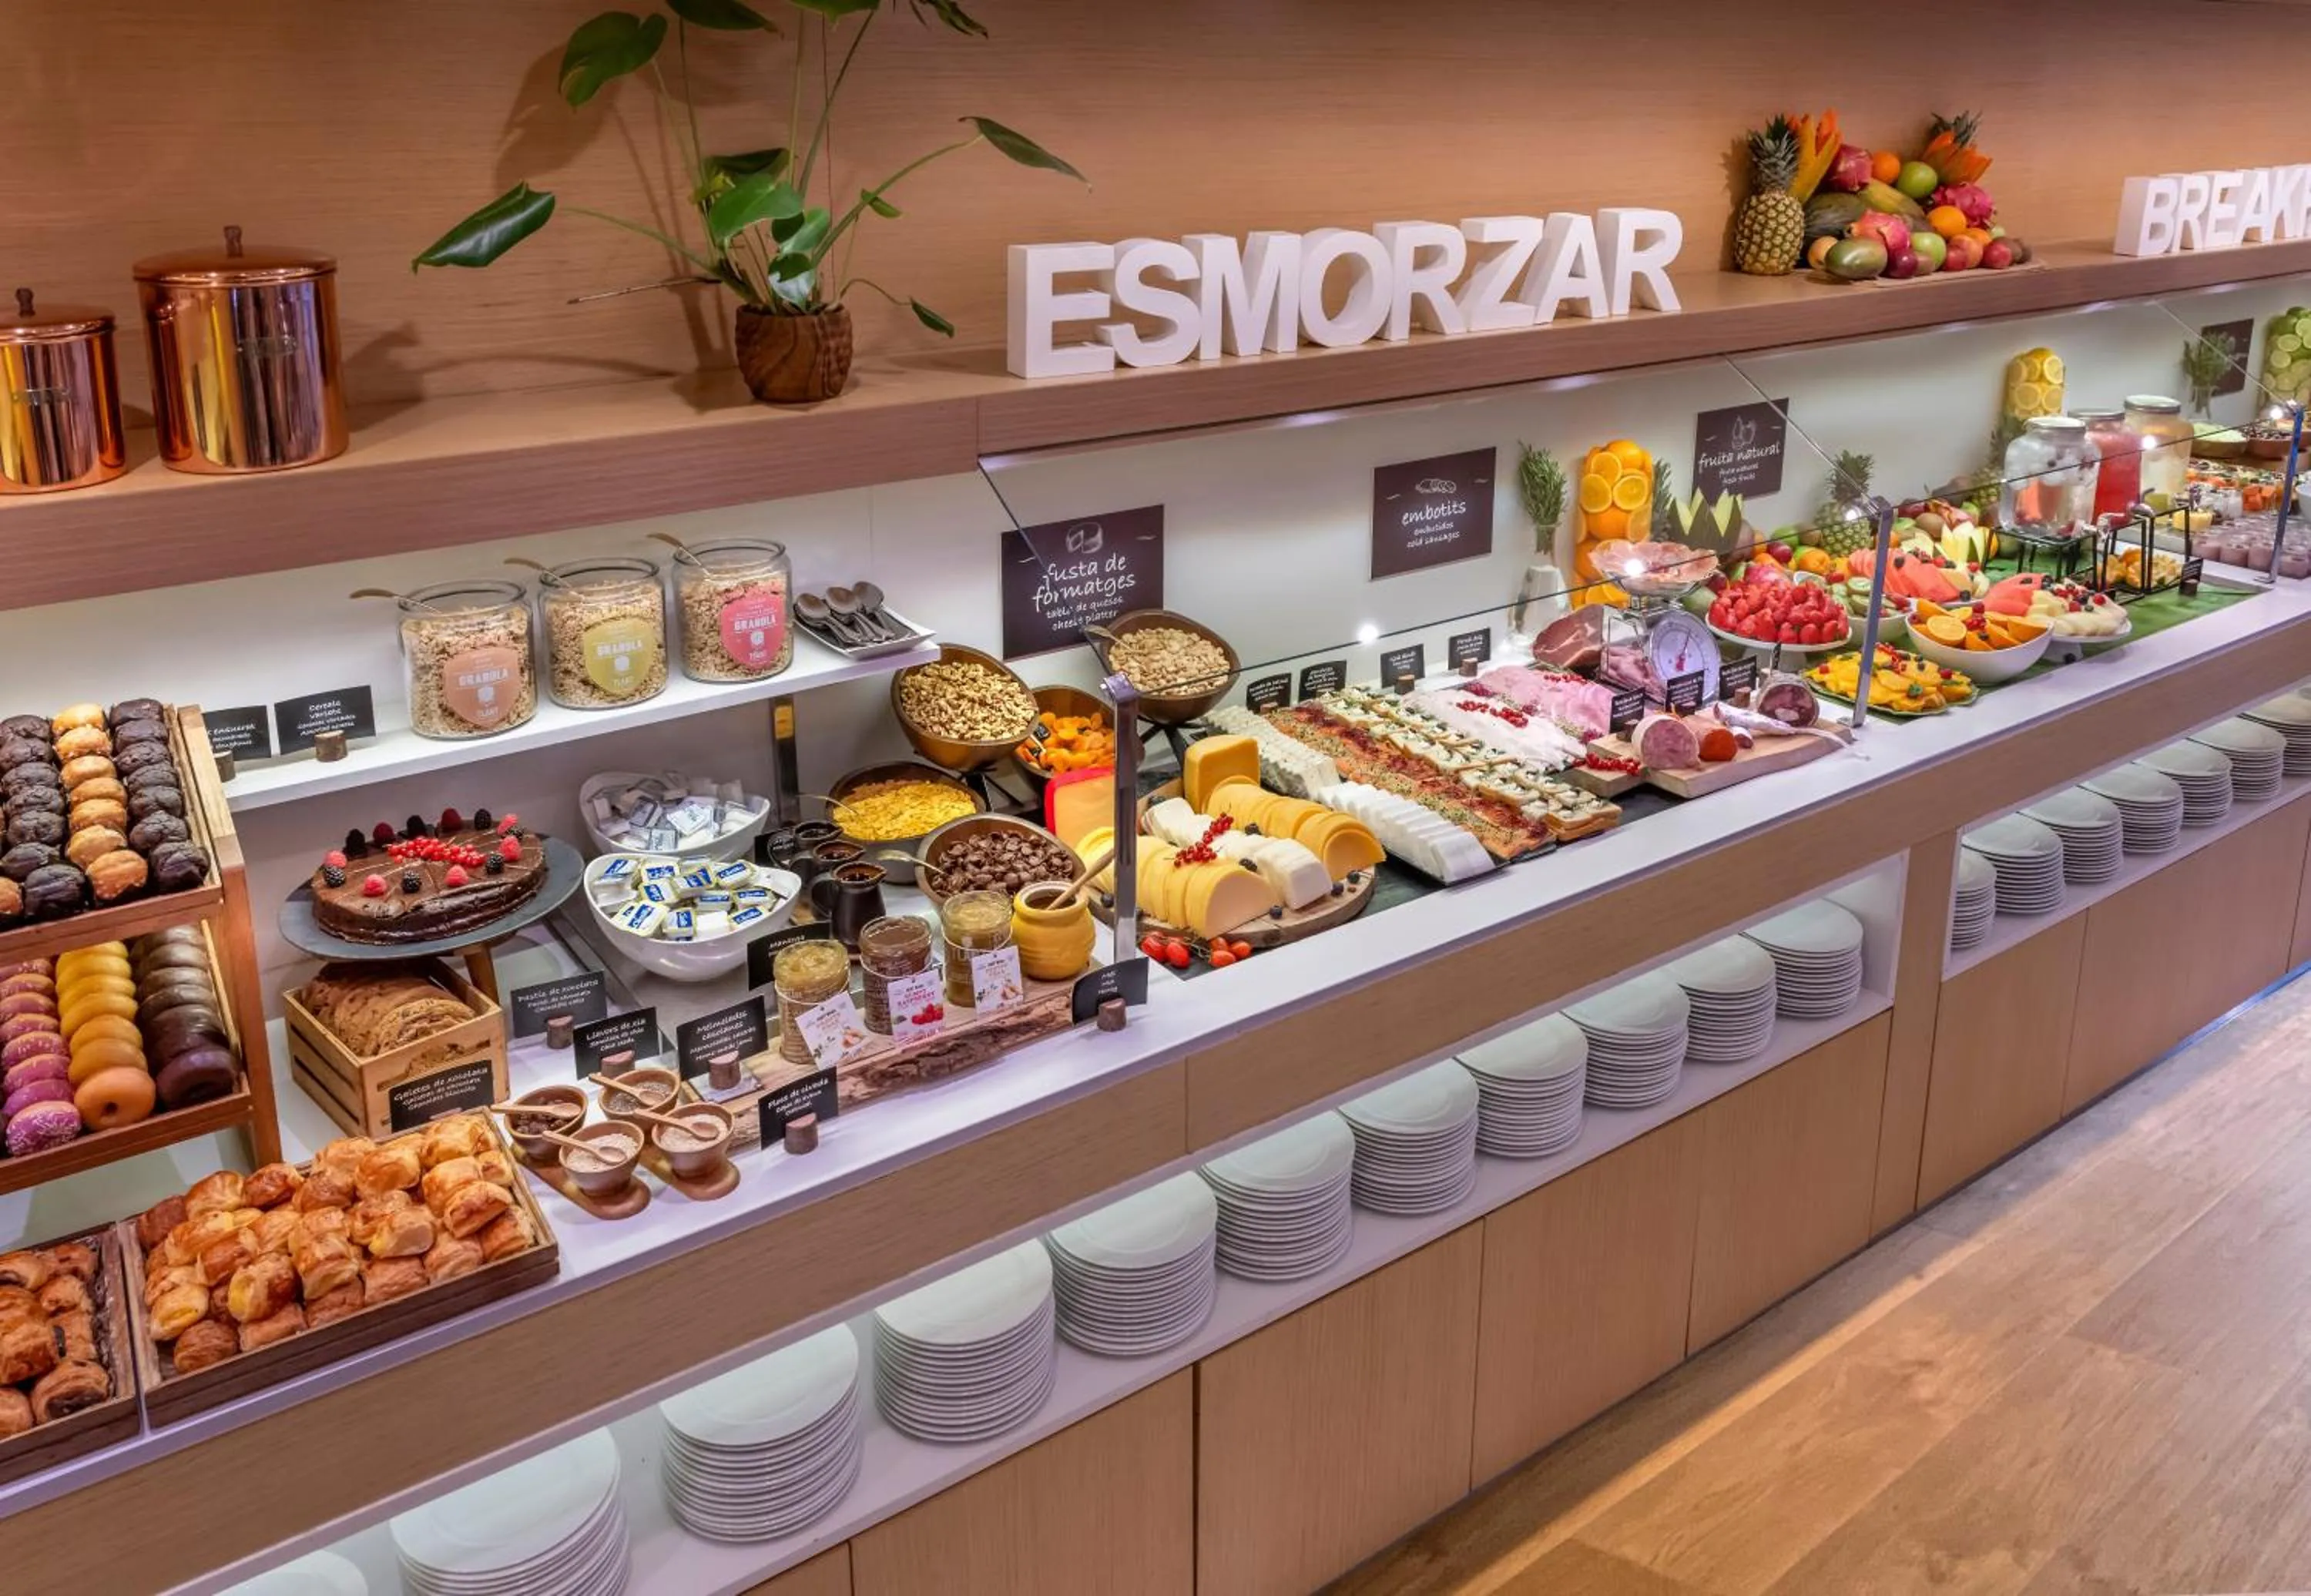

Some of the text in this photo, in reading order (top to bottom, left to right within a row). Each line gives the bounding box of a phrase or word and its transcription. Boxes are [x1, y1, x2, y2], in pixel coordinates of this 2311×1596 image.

[1008, 207, 1682, 378] ESMORZAR
[1737, 441, 1780, 461] natural
[1401, 500, 1466, 526] embotits
[1043, 552, 1126, 591] fusta de
[1031, 573, 1136, 613] formatges
[1075, 602, 1087, 612] de
[1085, 609, 1118, 625] platter
